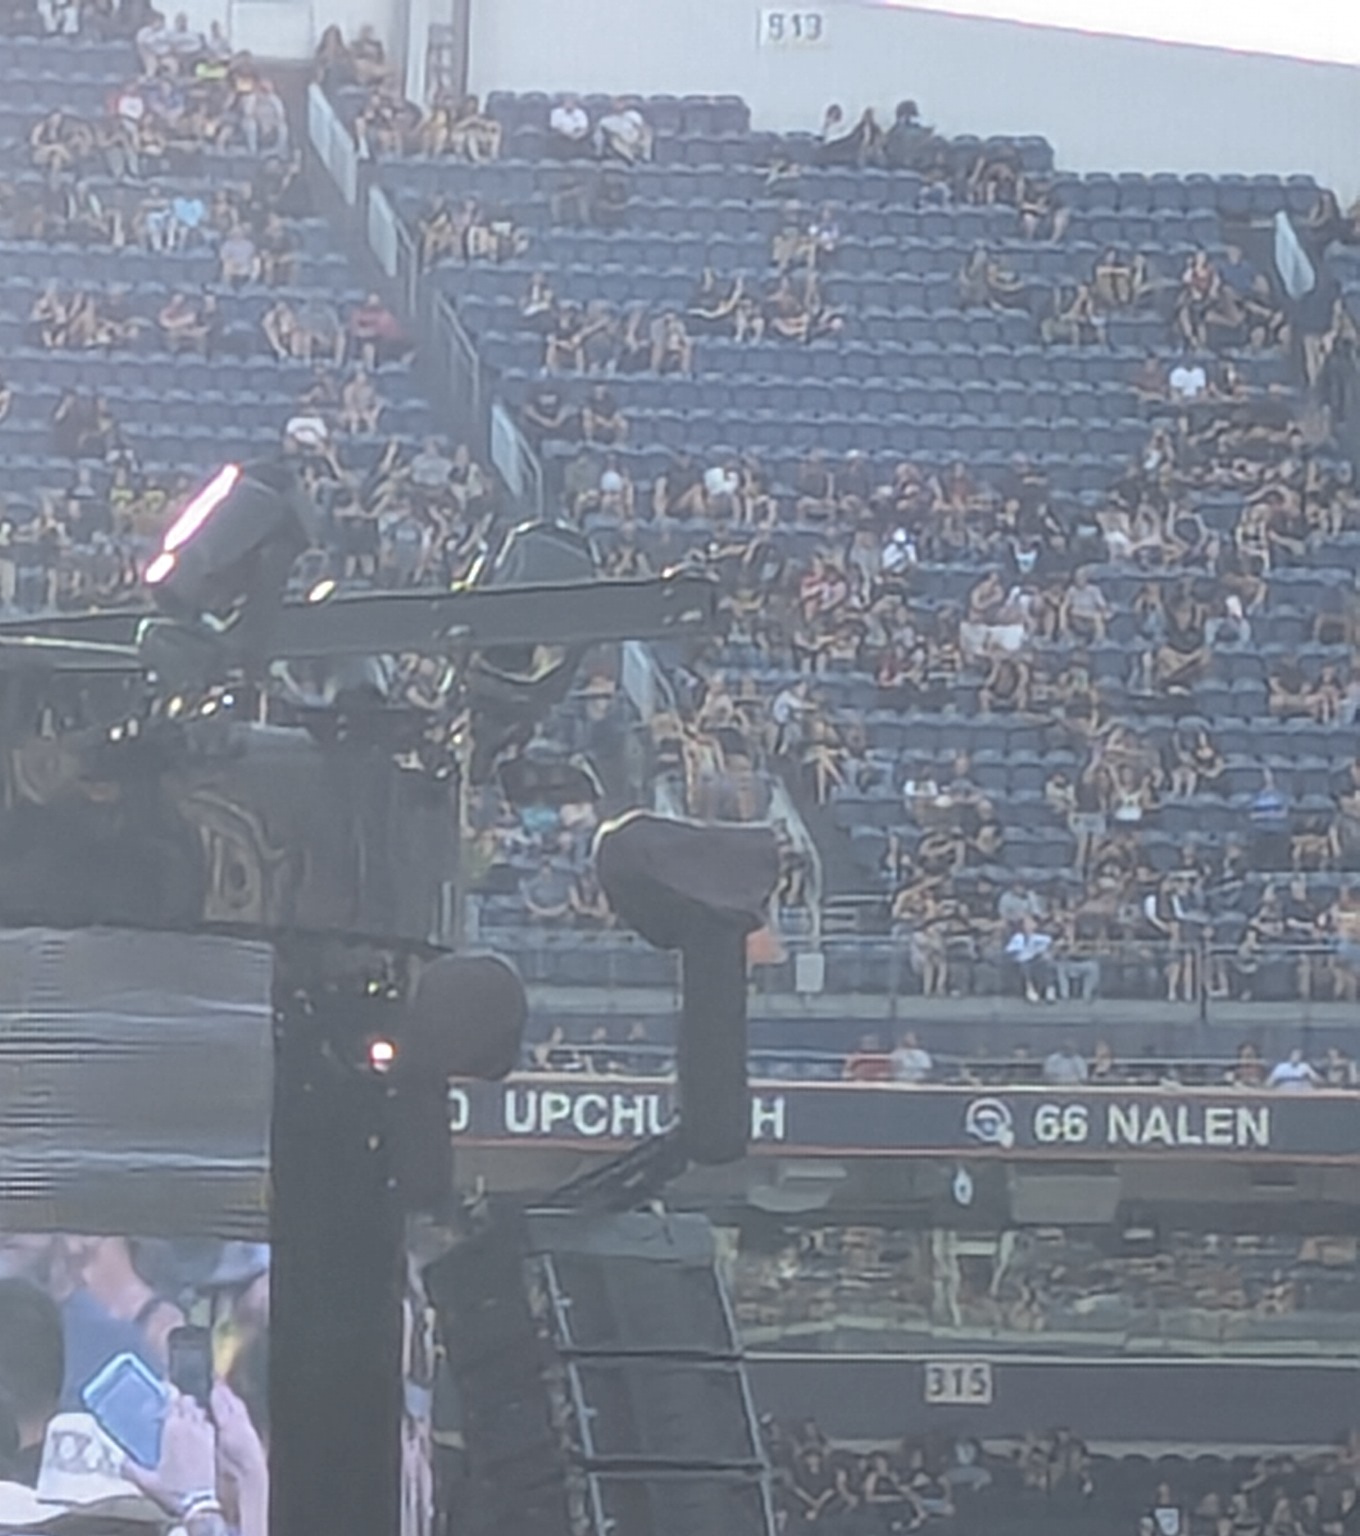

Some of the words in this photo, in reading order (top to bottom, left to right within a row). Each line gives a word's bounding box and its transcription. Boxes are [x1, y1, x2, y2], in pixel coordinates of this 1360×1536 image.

[505, 1089, 785, 1141] UPCHUH
[1034, 1103, 1089, 1143] 66
[1107, 1104, 1270, 1147] NALEN
[927, 1366, 988, 1397] 315
